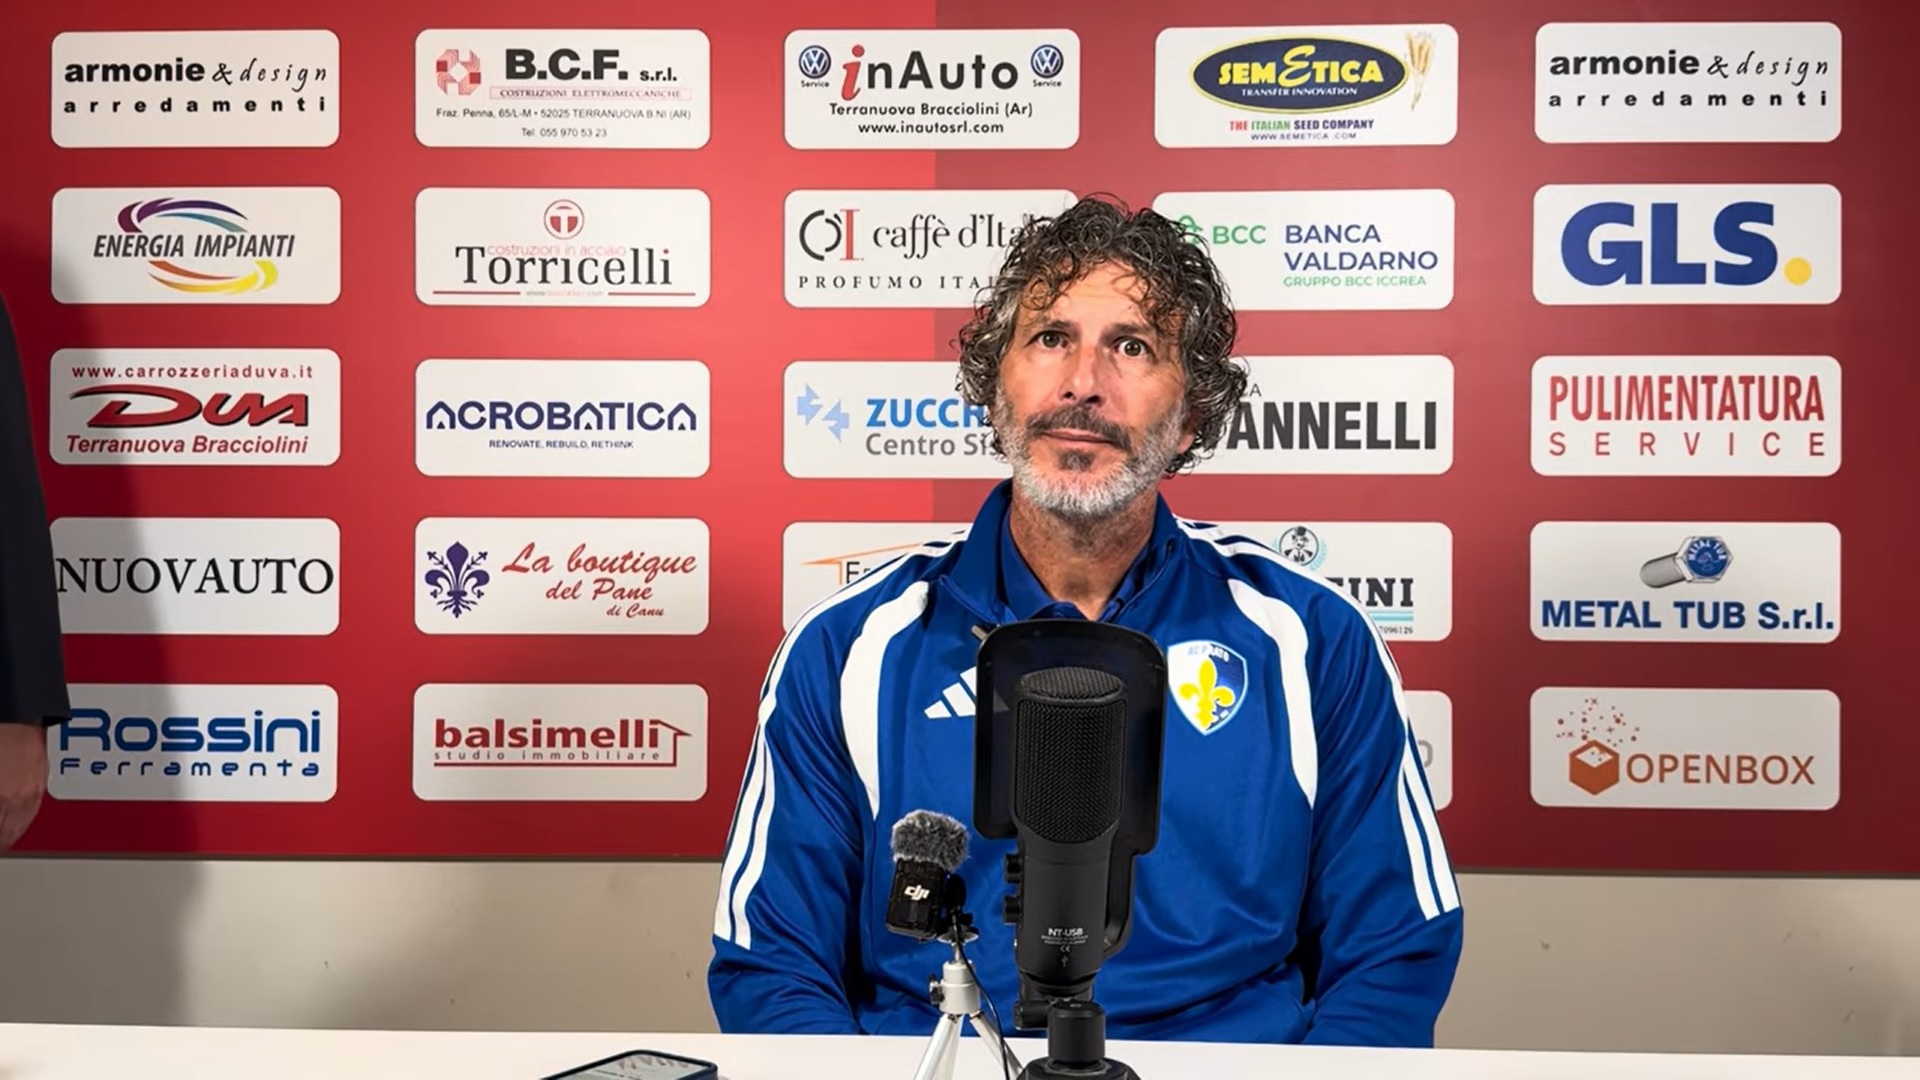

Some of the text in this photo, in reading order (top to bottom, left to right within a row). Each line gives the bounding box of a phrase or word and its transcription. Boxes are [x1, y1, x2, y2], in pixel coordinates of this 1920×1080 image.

[505, 48, 677, 81] B.C.F. s.r.l.
[841, 45, 1018, 101] inAuto
[1218, 45, 1384, 87] SEMETICA
[1550, 50, 1828, 86] armonie & design
[65, 57, 327, 93] armonie & design
[800, 80, 830, 88] Service
[1033, 79, 1062, 87] Service
[572, 90, 681, 98] ELETTROMECCANICHE
[1242, 87, 1357, 96] TRANSFER INNOVATION
[1549, 91, 1826, 106] arredamenti
[64, 97, 325, 113] arredamenti
[463, 109, 495, 119] Penna,
[541, 109, 570, 118] 52025
[573, 109, 644, 119] TERRANUOVA
[670, 110, 691, 120] (AR)
[830, 102, 1032, 117] Terranuova Bracciolini (Ar)
[540, 128, 558, 137] 055
[561, 128, 578, 137] 970
[581, 128, 592, 137] 53
[595, 128, 607, 137] 23
[858, 121, 1004, 133] www.inautosrl.com
[1229, 119, 1374, 130] THE ITALIAN SEED COMPANY
[873, 214, 950, 259] caffè
[1213, 225, 1266, 244] BCC
[1285, 224, 1381, 243] BANCA
[93, 234, 295, 257] ENERGIA IMPIANTI
[487, 245, 627, 256] costruzioni in acciaio
[455, 246, 672, 284] Torricelli
[1284, 251, 1438, 271] VALDARNO
[799, 276, 922, 289] PROFUMO
[1283, 276, 1426, 287] GRUPPO BCC ICCREA
[72, 365, 312, 378] www.carrozzeriaduva.it
[1549, 375, 1824, 421] PULIMENTATURA
[426, 401, 697, 430] ACROBATICA
[67, 435, 308, 453] Terranuova Bracciolini
[489, 440, 633, 449] RENOVATE, REBUILD, RETHINK
[866, 433, 955, 455] Centro
[1549, 432, 1825, 456] SERVICE
[502, 542, 697, 584] La boutique
[55, 557, 334, 594] NUOVAUTO
[545, 577, 653, 600] del Pane
[1325, 577, 1413, 607] INI
[606, 602, 664, 618] di Canu
[1542, 600, 1833, 629] METAL TUB S.r.l.
[60, 708, 320, 753] Rossini
[435, 719, 659, 748] balsimelli
[435, 751, 659, 761] studio immobiliare
[60, 758, 319, 776] Ferramenta
[1626, 753, 1815, 785] OPENBOX
[1048, 928, 1083, 936] NT-USB
